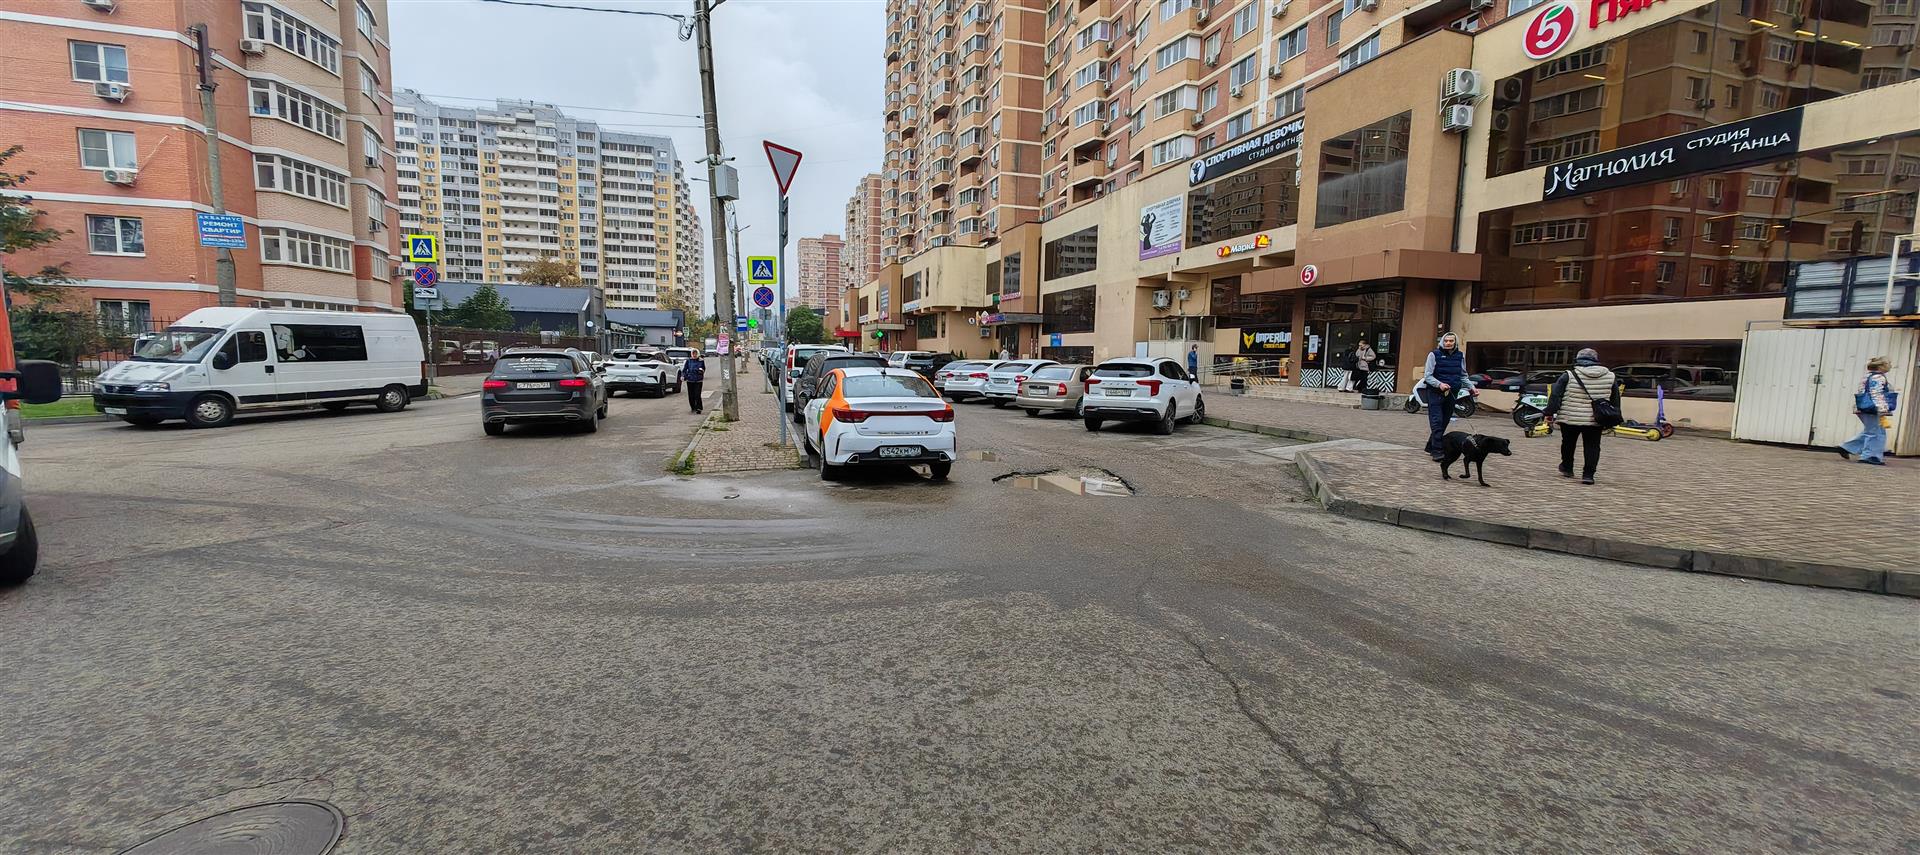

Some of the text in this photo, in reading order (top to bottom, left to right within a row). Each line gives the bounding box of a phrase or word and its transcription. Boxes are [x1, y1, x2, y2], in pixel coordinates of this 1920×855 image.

[1248, 134, 1302, 161] СТУДИЯ ФИТНЕ
[1686, 127, 1750, 151] СТУДИЯ
[1730, 132, 1791, 154] ТАНЦА
[1205, 136, 1261, 168] СПОРТИВНАЯ
[202, 220, 238, 228] РЕМОНТ
